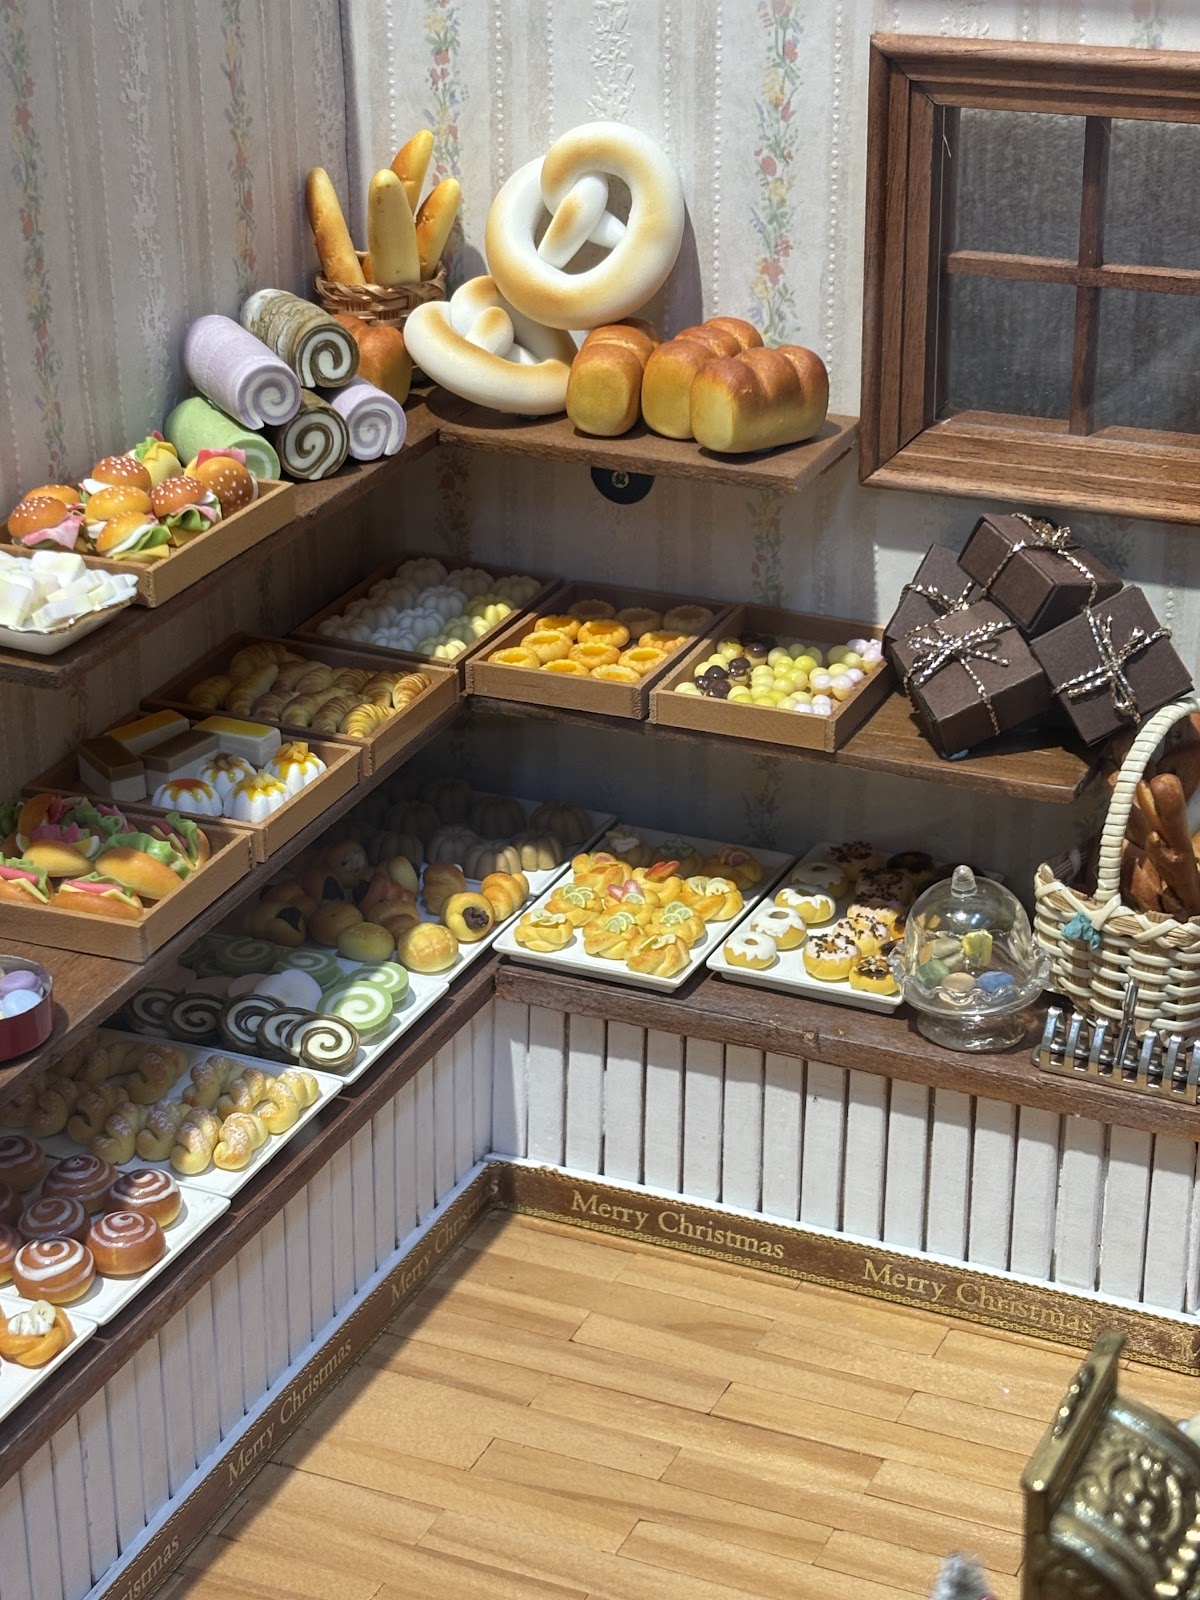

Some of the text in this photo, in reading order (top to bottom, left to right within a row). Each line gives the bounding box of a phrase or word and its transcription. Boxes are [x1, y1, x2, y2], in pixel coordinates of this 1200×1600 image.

[571, 1189, 785, 1260] Merry Christmas
[390, 1251, 431, 1308] Merry
[863, 1258, 1093, 1334] Merry Christmas
[228, 1338, 352, 1488] Merry Christmas
